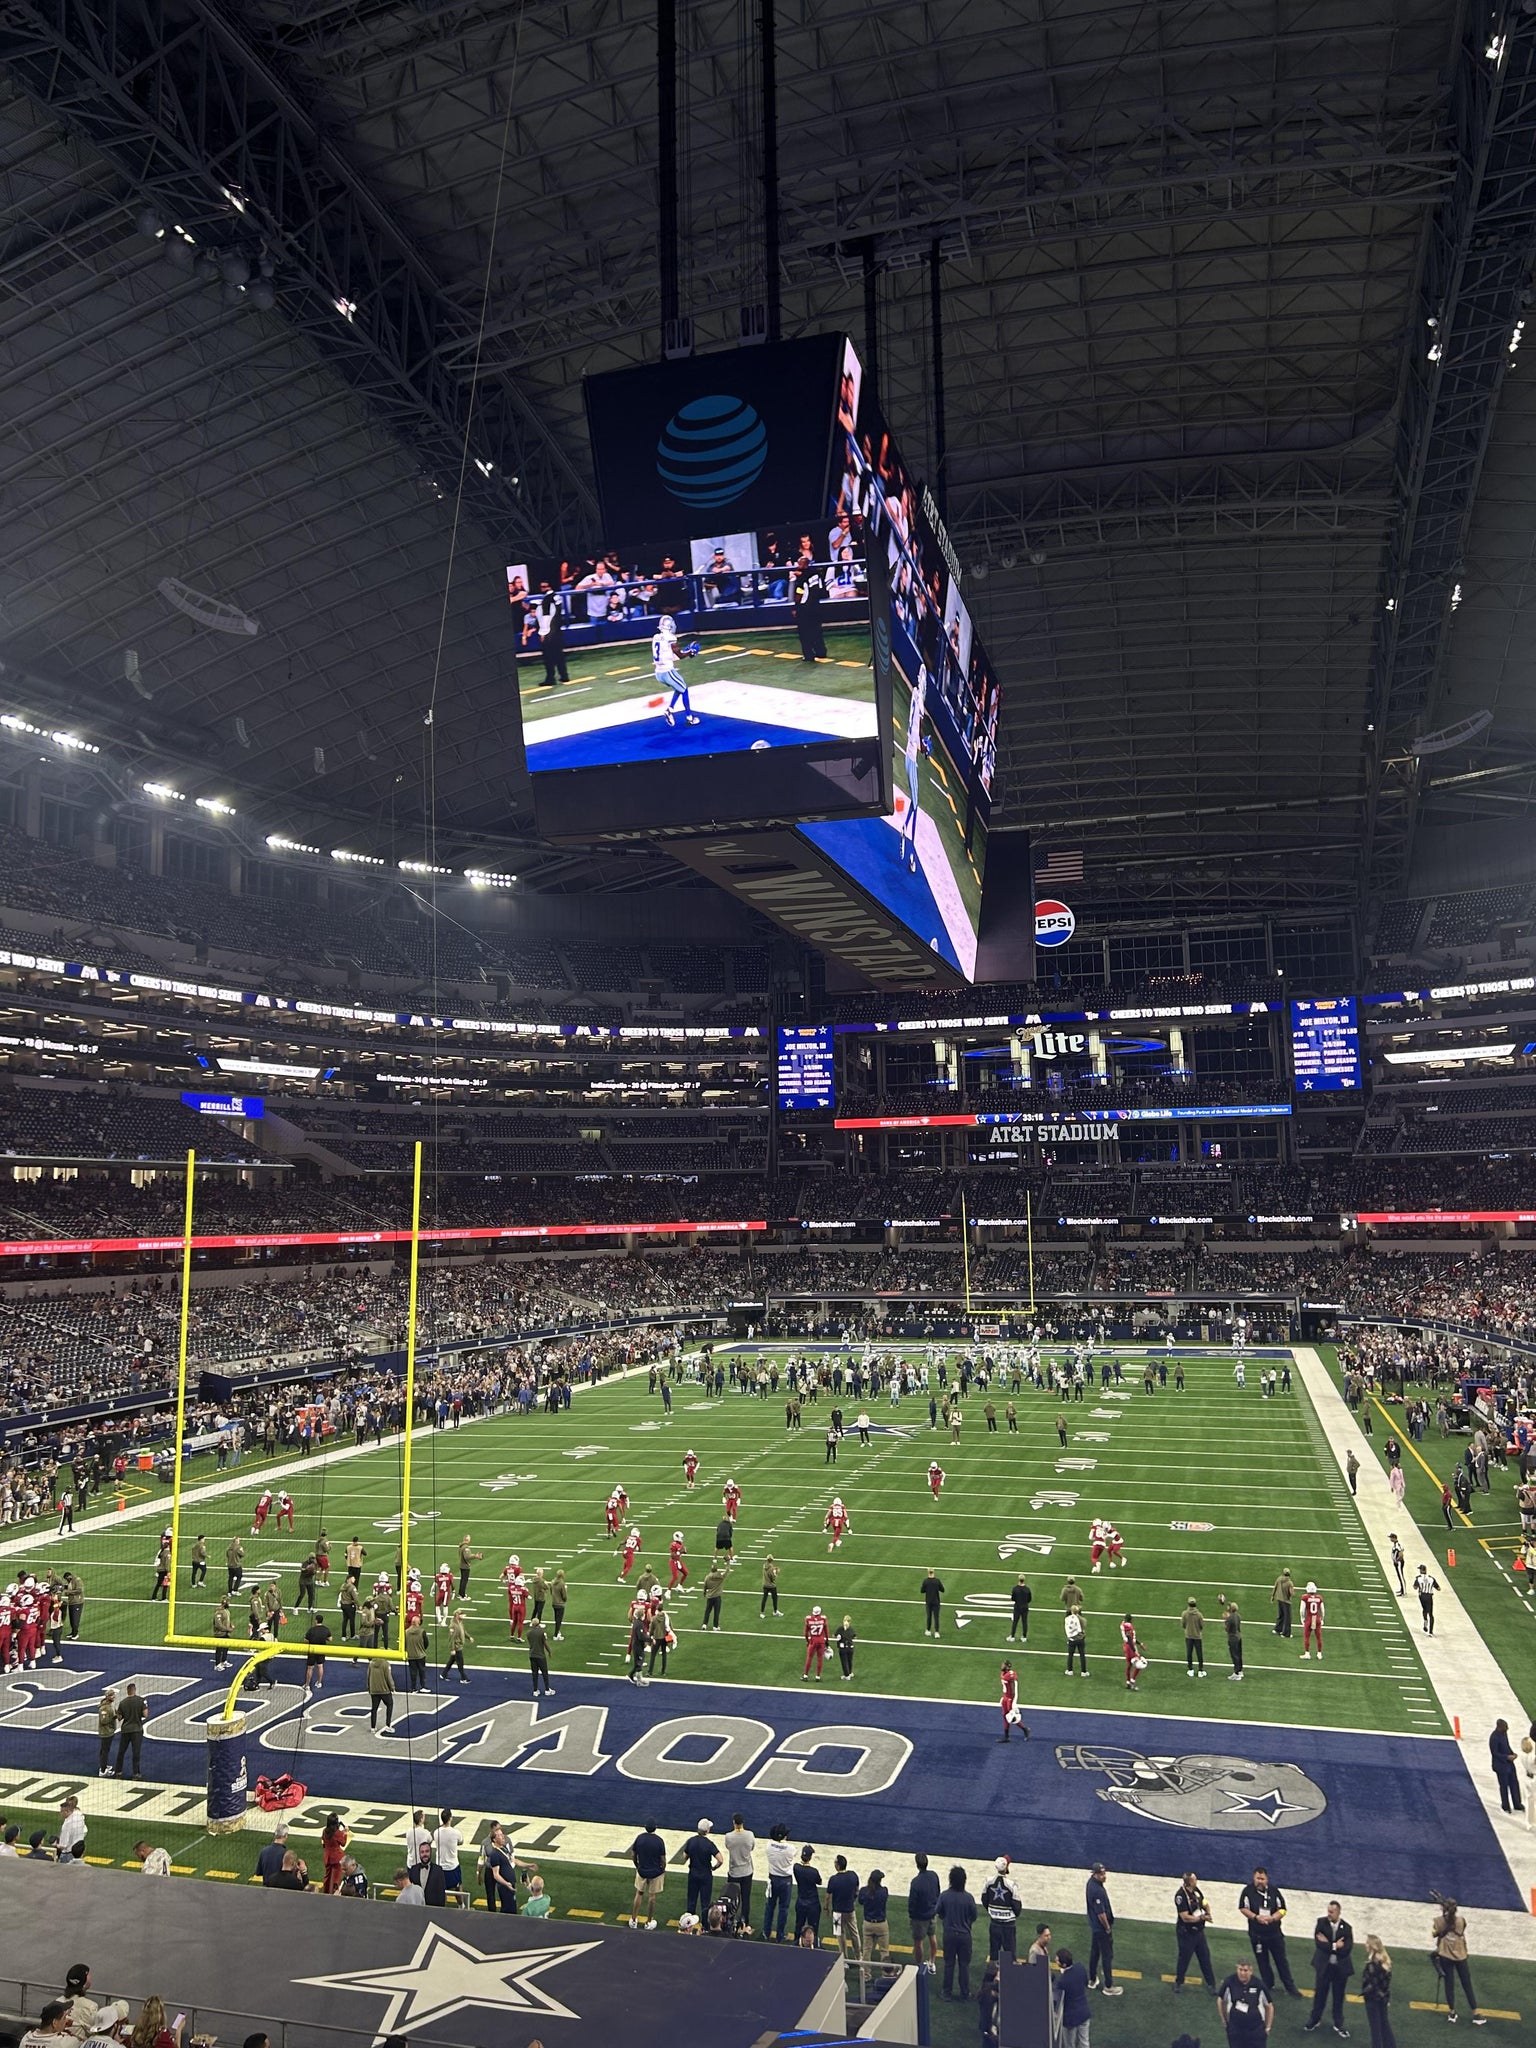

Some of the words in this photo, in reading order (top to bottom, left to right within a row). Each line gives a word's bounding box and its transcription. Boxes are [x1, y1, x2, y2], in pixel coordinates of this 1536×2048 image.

[654, 641, 660, 662] 3
[600, 815, 828, 841] WINSTAR
[733, 870, 938, 979] WINSTAR
[1034, 917, 1072, 928] EPSI
[12, 952, 35, 968] WHO
[36, 957, 65, 974] SERVE
[130, 974, 161, 990] CHEERS
[160, 978, 172, 991] TO
[173, 979, 198, 996] THOSE
[198, 984, 217, 999] WHO
[218, 989, 242, 1003] SERVE
[1430, 986, 1465, 998] CHEERS
[1465, 984, 1478, 995] TO
[1478, 981, 1510, 993] THOSE
[1510, 978, 1534, 990] WHO
[1110, 1009, 1141, 1020] CHEERS
[1141, 1008, 1153, 1018] TO
[1153, 1006, 1181, 1017] THOSE
[1182, 1005, 1204, 1016] WHO
[1204, 1004, 1232, 1015] SERVE
[452, 1020, 480, 1031] CHEERS
[480, 1021, 491, 1031] TO
[491, 1022, 516, 1033] THOSE
[517, 1023, 536, 1034] WHO
[536, 1024, 561, 1035] SERVE
[898, 1020, 926, 1031] CHEERS
[926, 1020, 937, 1029] TO
[937, 1018, 963, 1029] THOSE
[963, 1017, 983, 1027] WHO
[984, 1016, 1009, 1026] SERVE
[1300, 1018, 1312, 1026] JOE
[619, 1027, 648, 1036] CHEERS
[648, 1027, 659, 1036] TO
[659, 1027, 684, 1037] THOSE
[685, 1027, 705, 1037] WHO
[705, 1027, 730, 1036] SERVE
[43, 1040, 73, 1051] Houston
[1032, 1031, 1085, 1060] Lite
[387, 1075, 411, 1083] Francisco
[440, 1077, 452, 1085] York
[590, 1082, 627, 1090] Indianapolis
[648, 1082, 679, 1090] Pittsburgh
[200, 1102, 231, 1111] MERRILL
[994, 1114, 1000, 1123] 0
[1022, 1113, 1044, 1122] 33:15
[1103, 1111, 1108, 1119] 0
[990, 1125, 1034, 1143] AT&T
[1038, 1123, 1119, 1142] STADIUM
[1257, 1215, 1313, 1223] Blockchain.com
[1029, 1490, 1080, 1507] 30
[832, 1508, 843, 1518] 85
[997, 1533, 1057, 1555] 20
[440, 1581, 447, 1592] 4
[512, 1595, 522, 1605] 31
[407, 1601, 416, 1611] 14
[955, 1593, 1015, 1621] 10
[1310, 1602, 1317, 1614] 0
[810, 1625, 824, 1636] 27
[354, 1875, 365, 1884] 12
